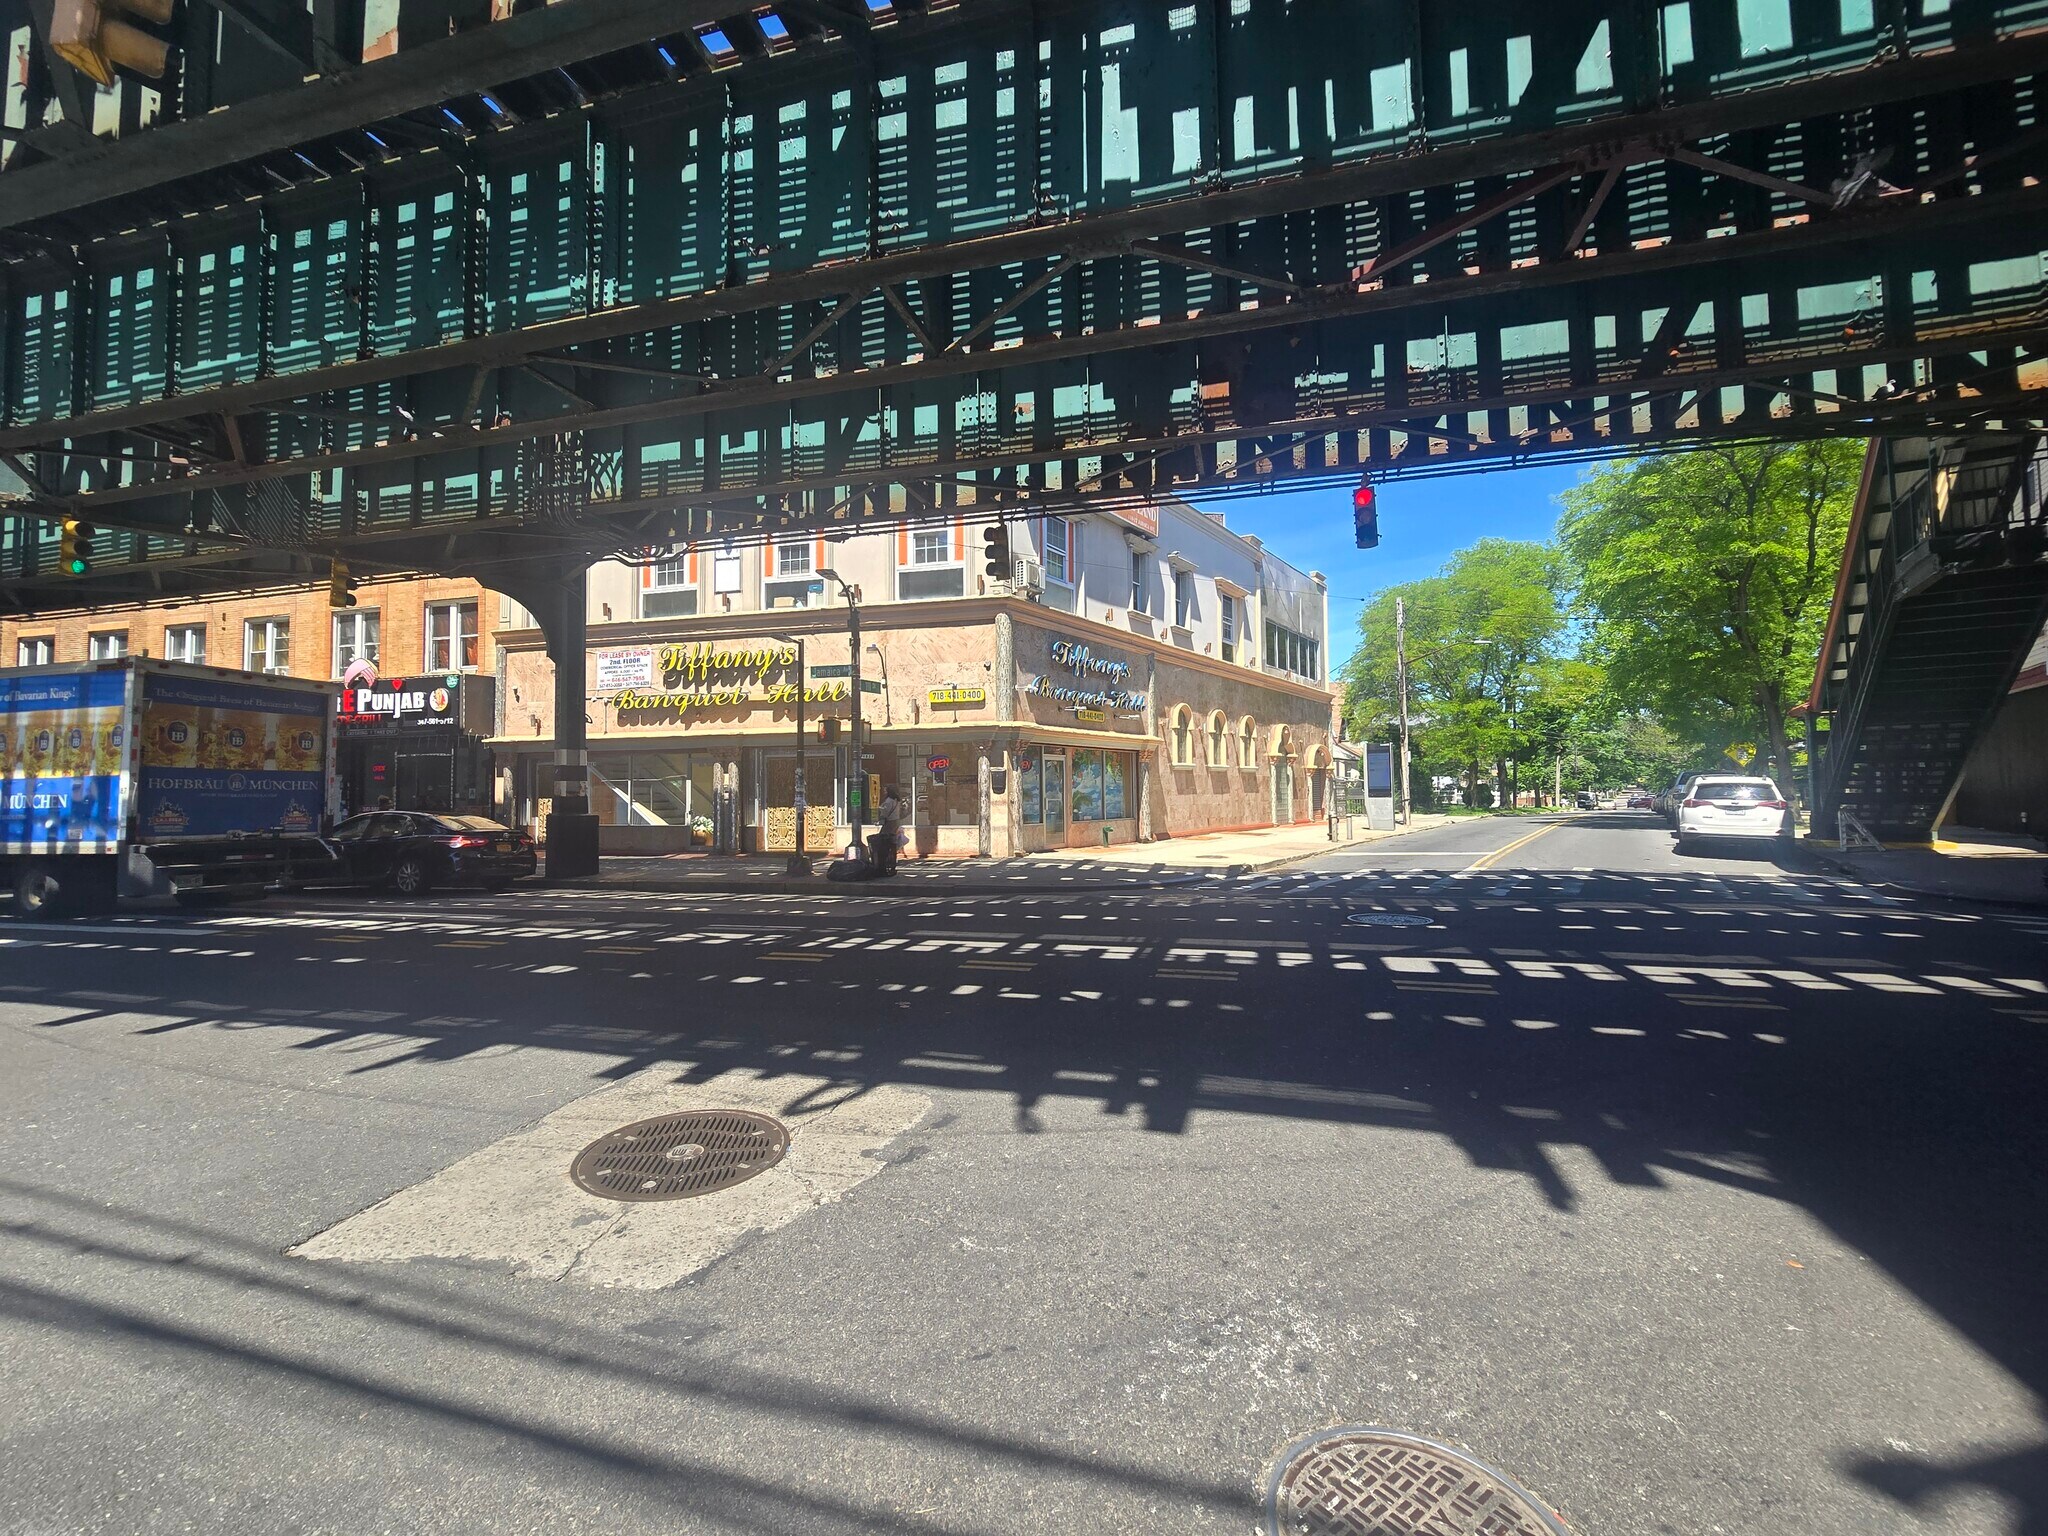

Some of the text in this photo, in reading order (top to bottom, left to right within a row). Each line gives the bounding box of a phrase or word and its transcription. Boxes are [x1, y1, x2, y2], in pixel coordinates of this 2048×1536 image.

[658, 641, 796, 681] Tiffany's
[1052, 641, 1131, 685] Tiffany's
[812, 667, 840, 677] Jamaica
[15, 689, 48, 702] Bavarian
[50, 687, 76, 702] Kings!
[154, 687, 174, 698] The
[767, 681, 848, 704] Hall
[1030, 675, 1147, 712] Banquet Hall
[611, 687, 747, 716] Banquet
[171, 731, 185, 741] HB
[232, 736, 243, 745] HB
[301, 740, 312, 749] HB
[928, 758, 949, 769] OPEN
[149, 777, 224, 790] HOFBRÄU
[250, 779, 319, 791] MÜNCHEN
[4, 793, 68, 810] MÜNCHEN
